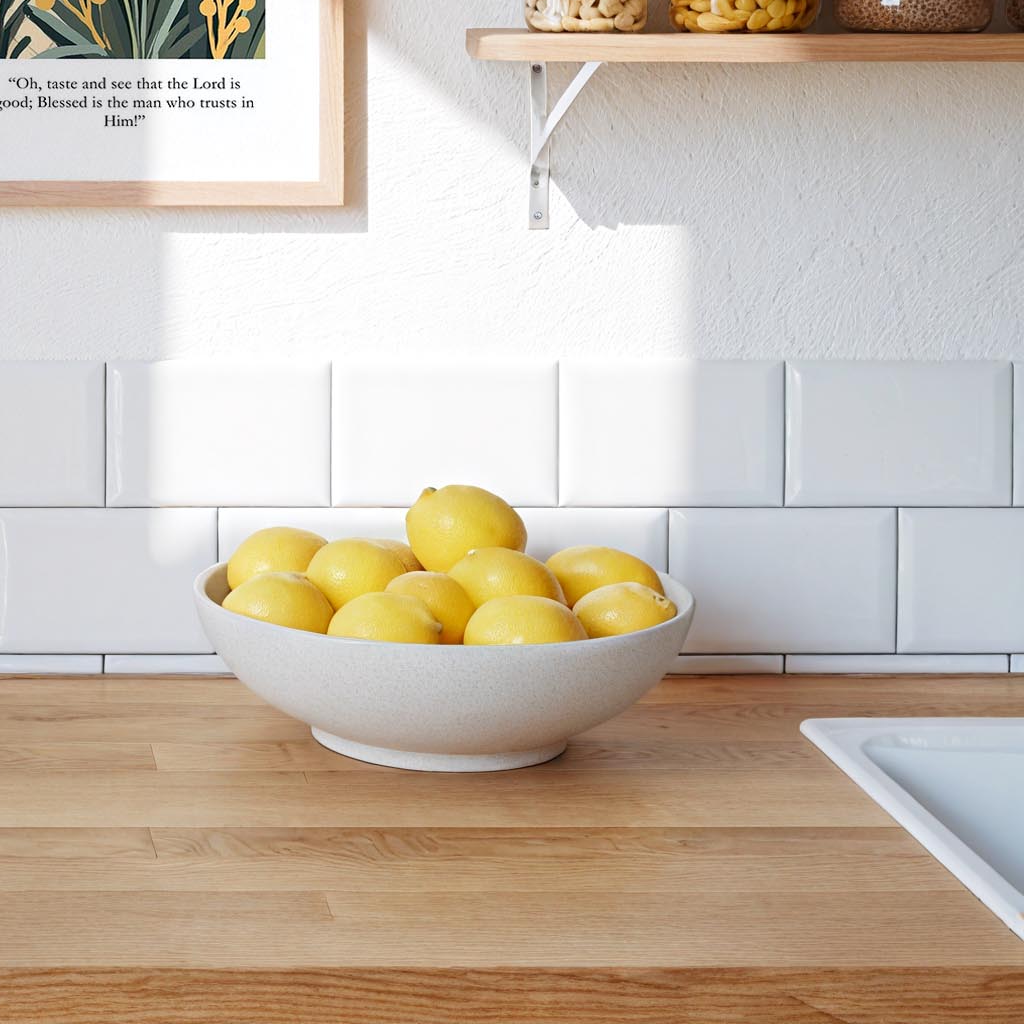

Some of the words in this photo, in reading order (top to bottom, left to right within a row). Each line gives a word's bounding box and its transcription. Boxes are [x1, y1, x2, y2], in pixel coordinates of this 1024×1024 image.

[8, 76, 43, 92] “Oh,
[46, 79, 78, 90] taste
[81, 76, 107, 90] and
[111, 80, 132, 90] see
[136, 76, 163, 90] that
[167, 76, 188, 90] the
[193, 76, 226, 90] Lord
[230, 76, 241, 90] is
[37, 95, 88, 109] Blessed
[92, 95, 103, 109] is
[107, 95, 129, 109] the
[132, 99, 162, 109] man
[166, 95, 196, 109] who
[200, 98, 237, 109] trusts
[241, 95, 255, 109] in
[104, 114, 146, 128] Him!”
